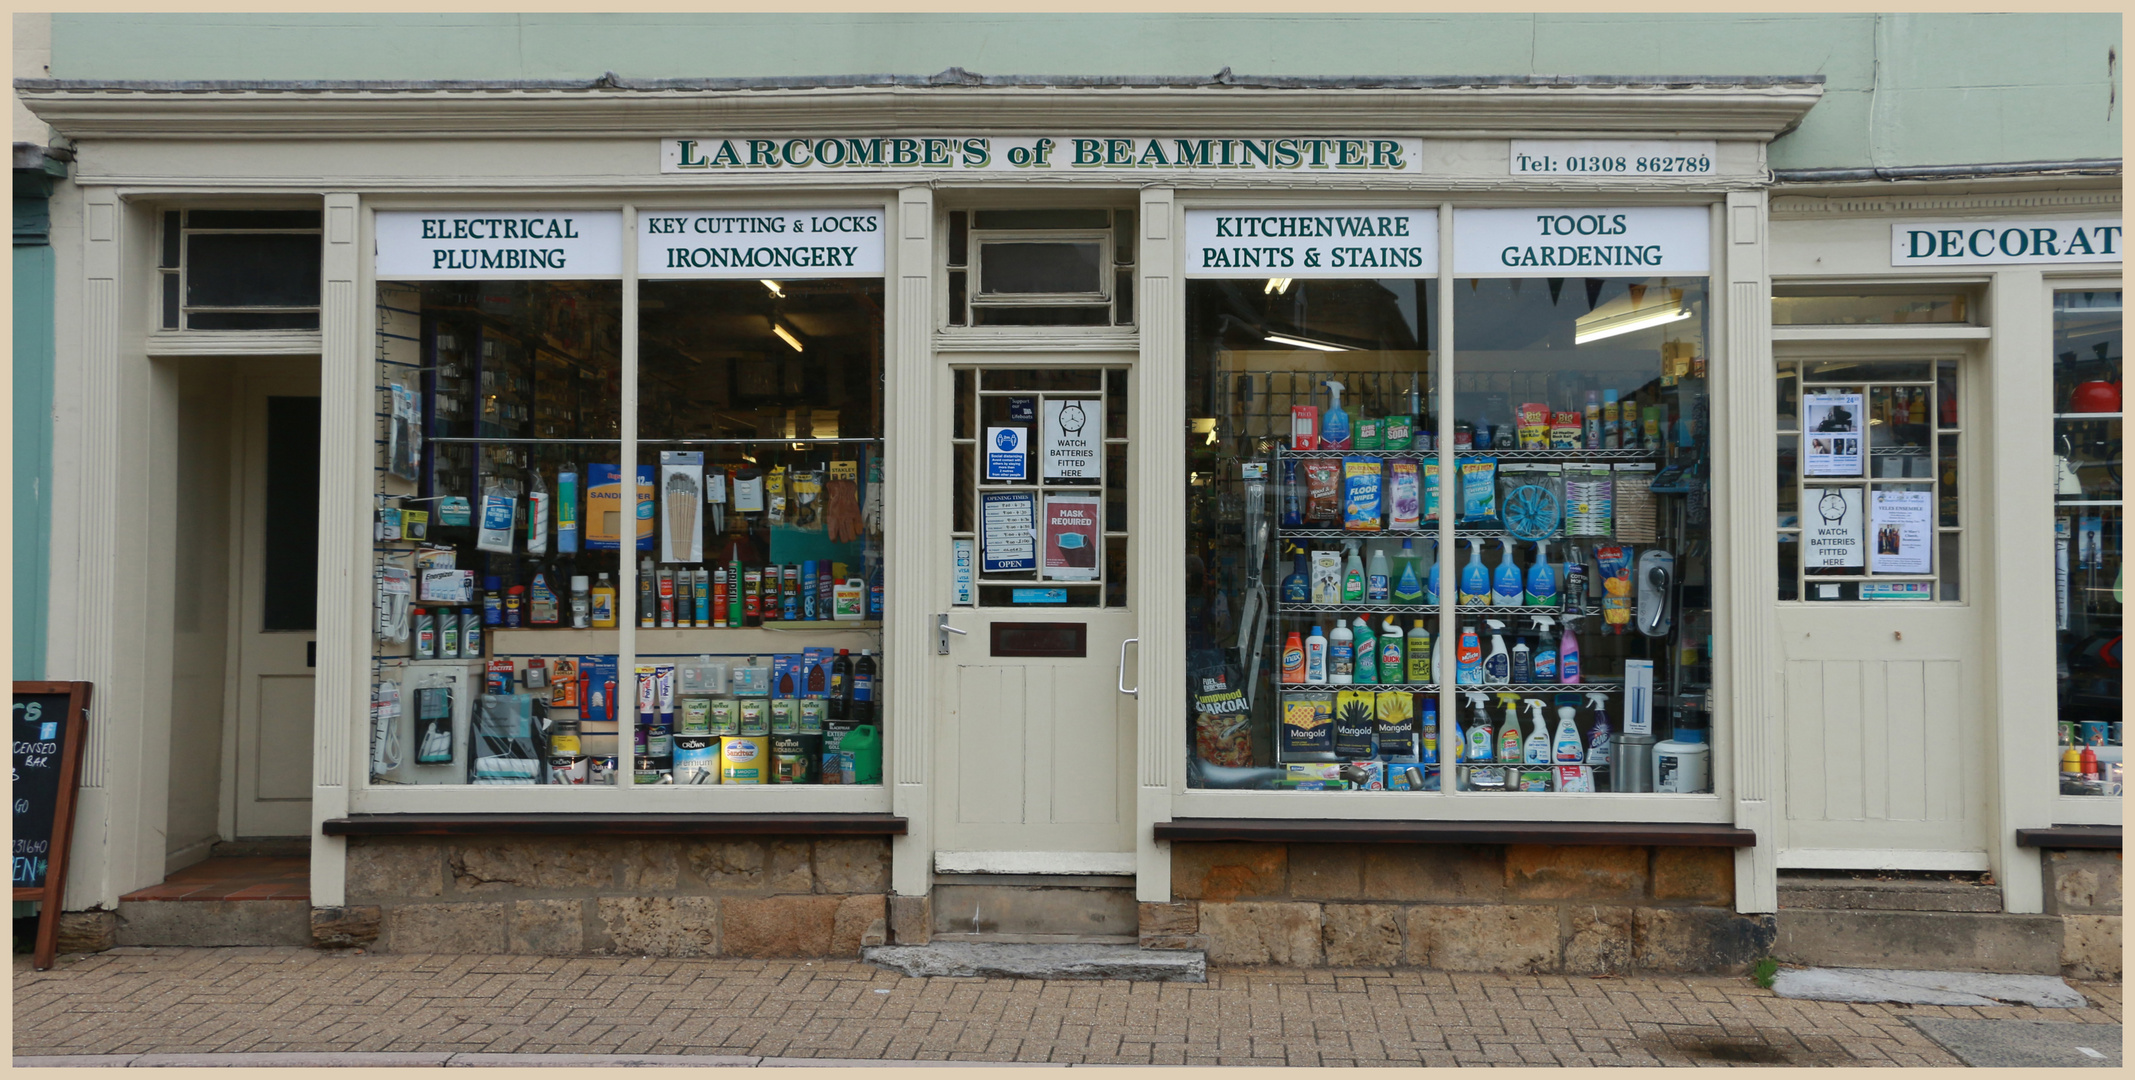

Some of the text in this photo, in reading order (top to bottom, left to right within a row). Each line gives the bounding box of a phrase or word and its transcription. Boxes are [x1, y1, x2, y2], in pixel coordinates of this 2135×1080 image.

[677, 138, 1408, 170] LARCOMBE'S of BEAMINSTER
[1517, 156, 1711, 173] Tel: 01308 862789
[421, 218, 579, 240] ELECTRICAL
[649, 216, 878, 234] KEY CUTTING & LOCKS
[1216, 216, 1410, 238] KITCHENWARE
[1537, 214, 1627, 236] TOOLS
[1907, 226, 2122, 258] DECORAT
[433, 248, 567, 270] PLUMBING
[667, 246, 859, 268] IRONMONGERY
[1203, 247, 1423, 268] PAINTS & STAINS
[1502, 245, 1663, 267] GARDENING
[1526, 411, 1542, 419] Big
[1558, 413, 1573, 422] Big
[1361, 429, 1376, 438] ACID
[1387, 429, 1409, 439] SODA
[1050, 449, 1094, 457] BATTERIES
[1058, 459, 1086, 467] FITTED
[1061, 469, 1082, 477] HERE
[1350, 485, 1378, 496] FLOOR
[590, 491, 652, 501] SANDER
[1354, 494, 1375, 502] WIPES
[1060, 509, 1084, 517] MASK
[1051, 517, 1092, 526] REQUIRED
[1818, 528, 1848, 536] WATCH
[1811, 538, 1856, 546] BATTERIES
[1819, 548, 1848, 556] FITTED
[998, 560, 1022, 568] OPEN
[1823, 558, 1845, 566] HERE
[425, 570, 454, 581] Energizer
[729, 567, 738, 605] GRIPFILL
[1383, 655, 1401, 663] DUCK
[1202, 677, 1216, 686] FUEL
[1195, 697, 1249, 716] CHARCOAL
[1338, 725, 1372, 737] Marigold
[1378, 723, 1412, 734] Marigold
[1291, 729, 1325, 740] Marigold
[682, 741, 705, 749] CROWN
[775, 740, 799, 749] Cuprinol
[727, 748, 754, 757] Sandtex
[25, 754, 47, 768] BAR
[676, 758, 714, 768] premium
[15, 799, 28, 814] GO
[13, 856, 38, 881] EN
